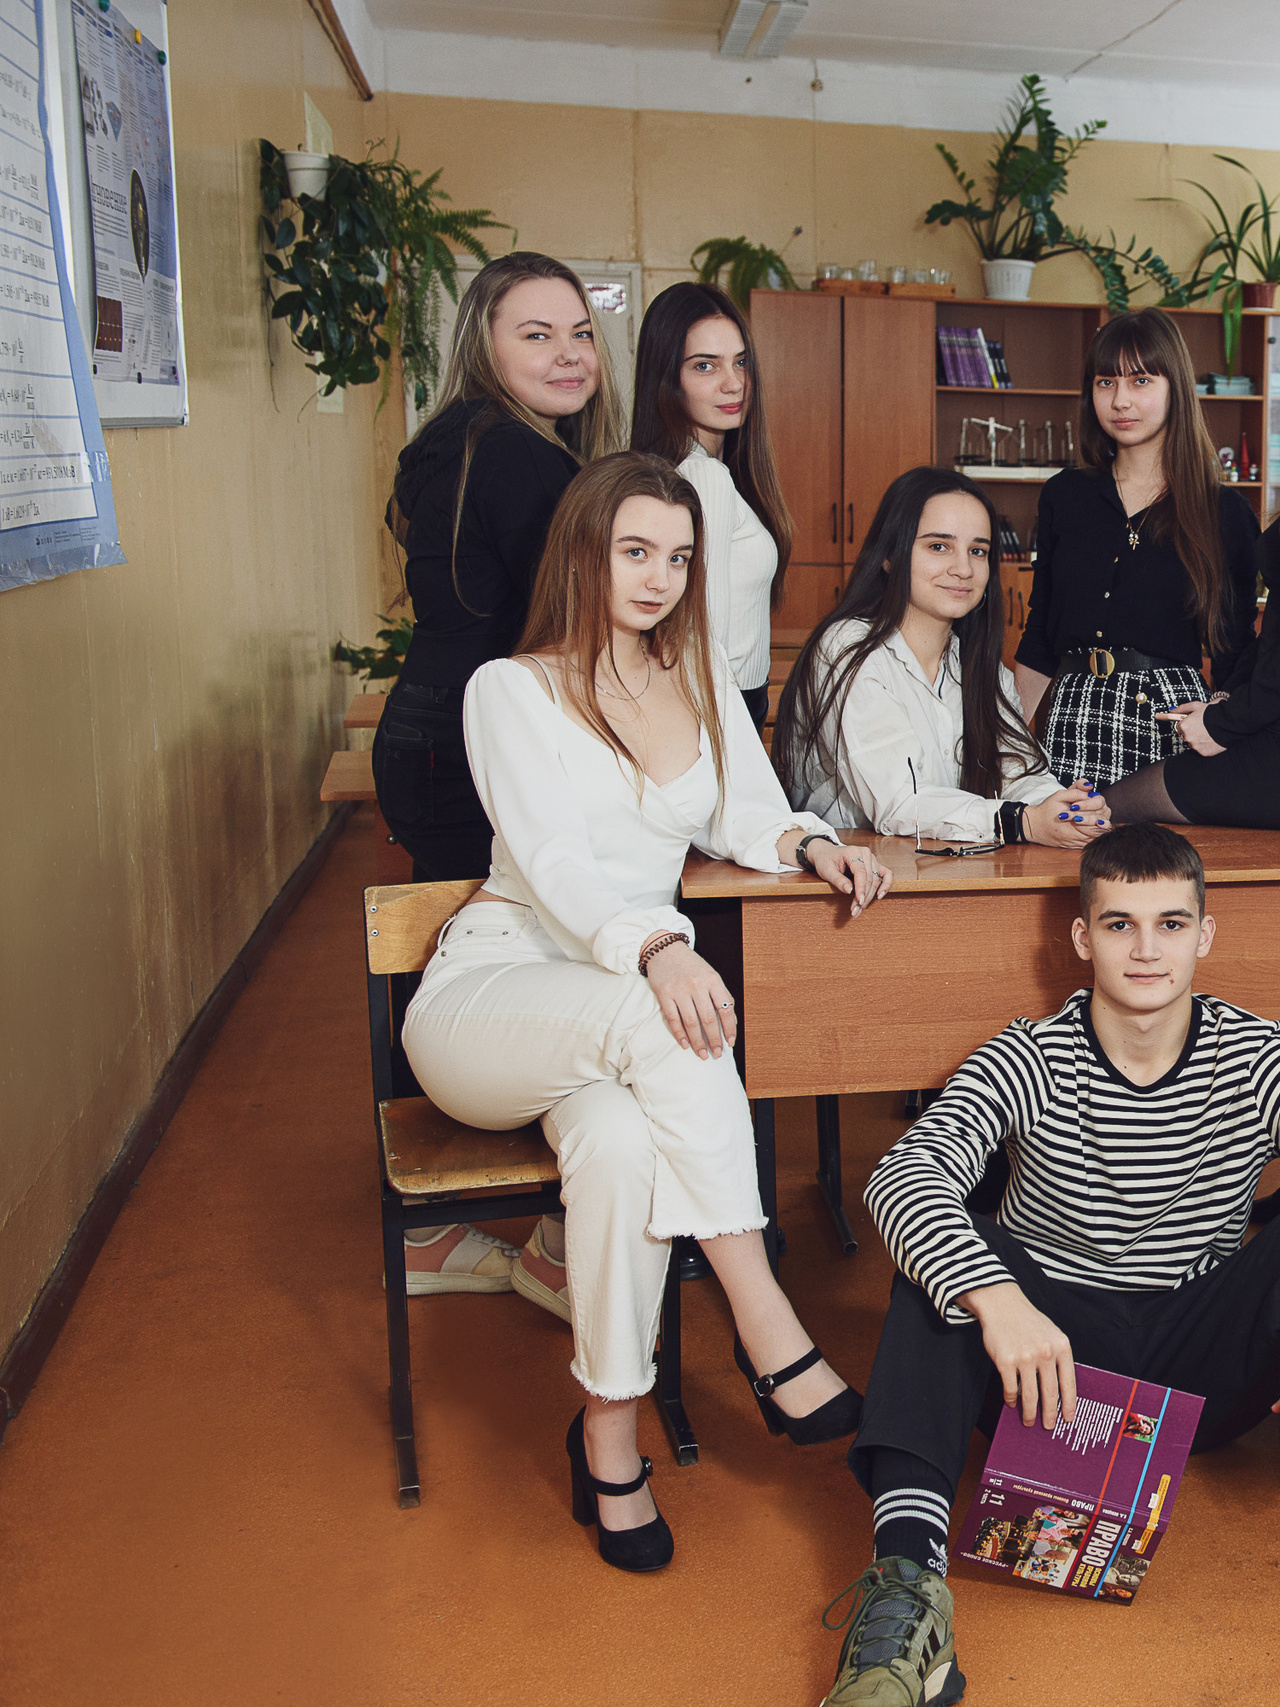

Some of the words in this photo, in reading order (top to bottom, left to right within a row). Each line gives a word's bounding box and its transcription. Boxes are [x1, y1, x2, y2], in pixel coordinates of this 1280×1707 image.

[989, 1493, 1005, 1506] 11
[1071, 1499, 1095, 1512] ПРАВО
[1081, 1520, 1122, 1567] ПРАВО
[1071, 1563, 1086, 1587] КУЛЬТУРЫ
